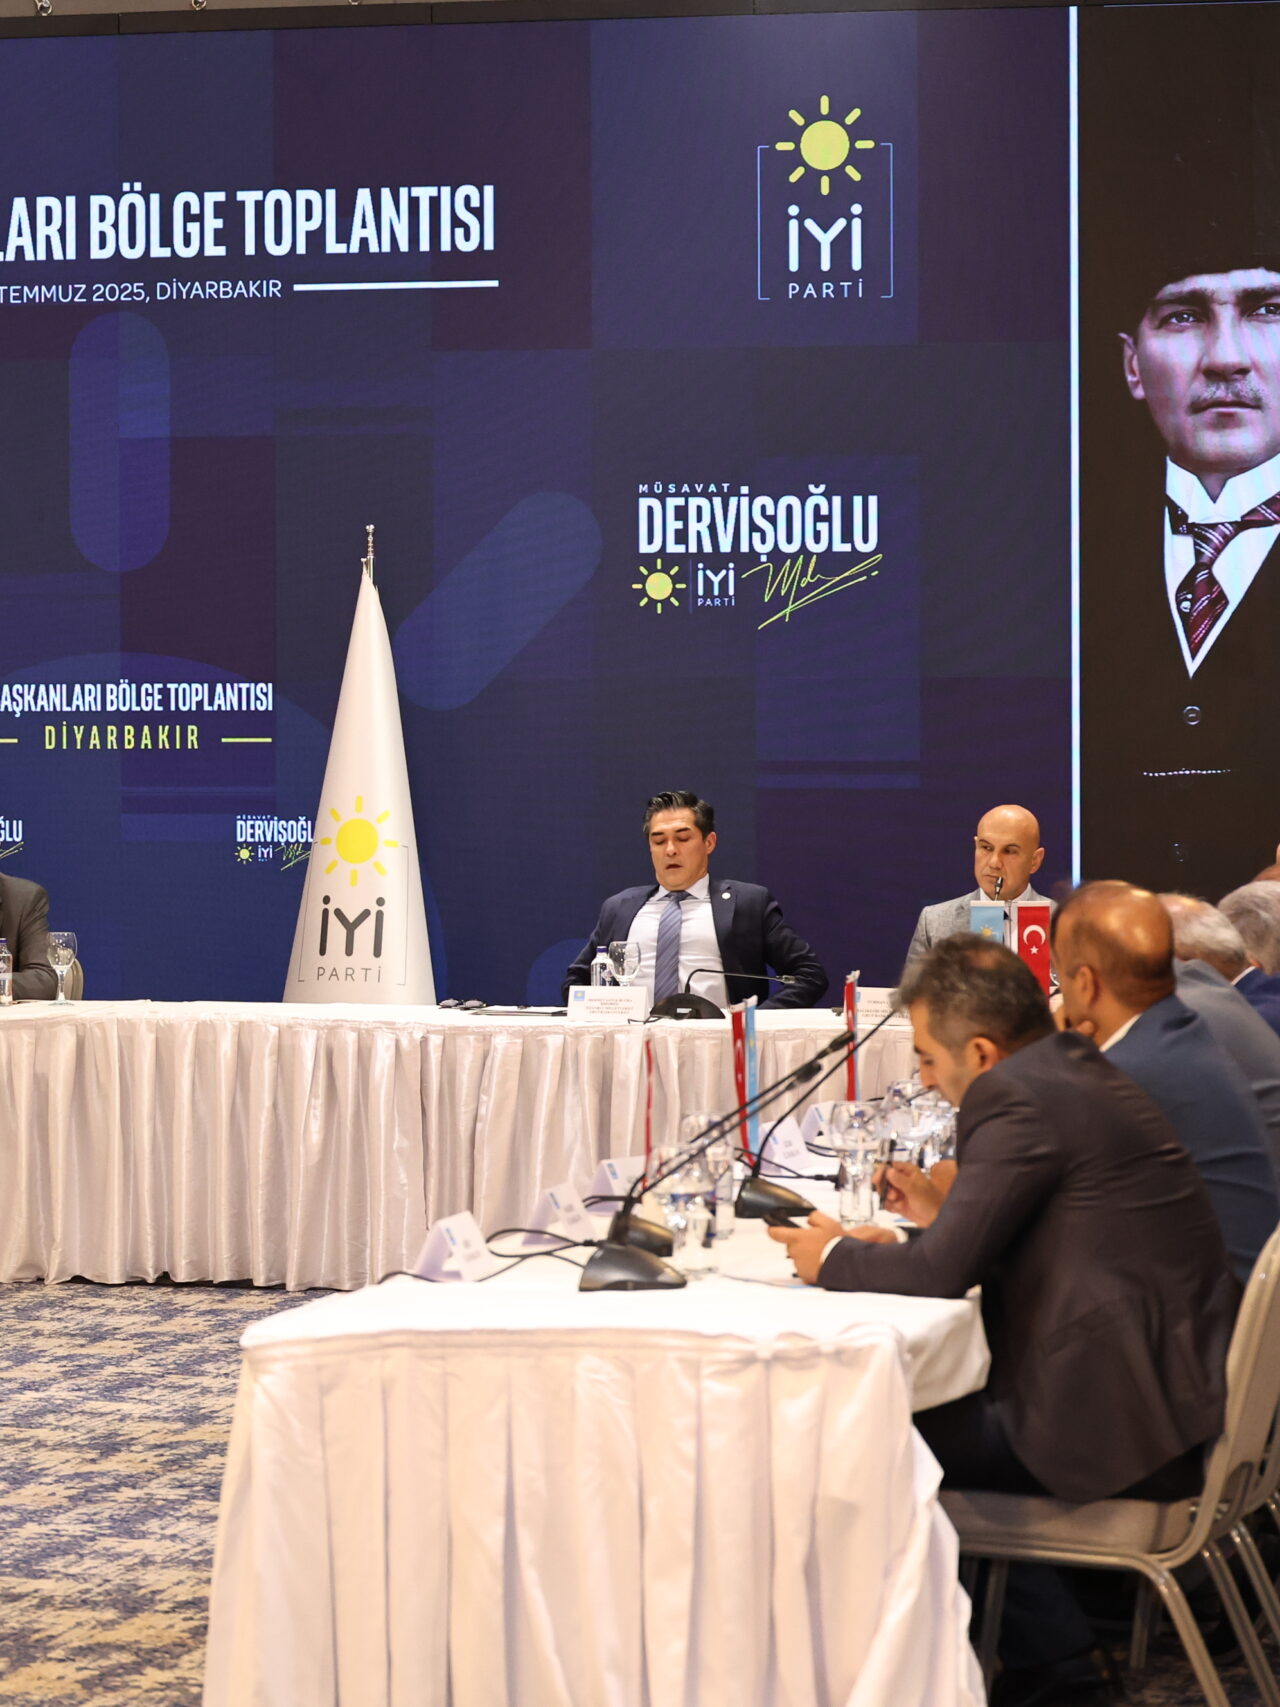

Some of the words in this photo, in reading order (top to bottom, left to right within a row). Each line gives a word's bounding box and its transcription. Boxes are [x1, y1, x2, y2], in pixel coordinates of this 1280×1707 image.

[89, 182, 227, 260] BÖLGE
[236, 184, 495, 257] TOPLANTISI
[787, 203, 863, 273] İYİ
[92, 282, 151, 303] 2025,
[156, 278, 282, 300] DİYARBAKIR
[788, 278, 863, 299] PARTİ
[638, 482, 731, 494] MÜSAVAT
[638, 483, 879, 562] DERVİŞOĞLU
[697, 562, 735, 596] İYİ
[697, 596, 736, 607] PARTİ
[105, 679, 163, 712] BÖLGE
[167, 682, 273, 712] TOPLANTISI
[44, 721, 199, 750] DİYARBAKIR
[236, 816, 314, 846] DERVİŞOĞL
[258, 845, 273, 858] İYİ
[319, 894, 386, 959] İYİ
[316, 965, 382, 983] PARTİ
